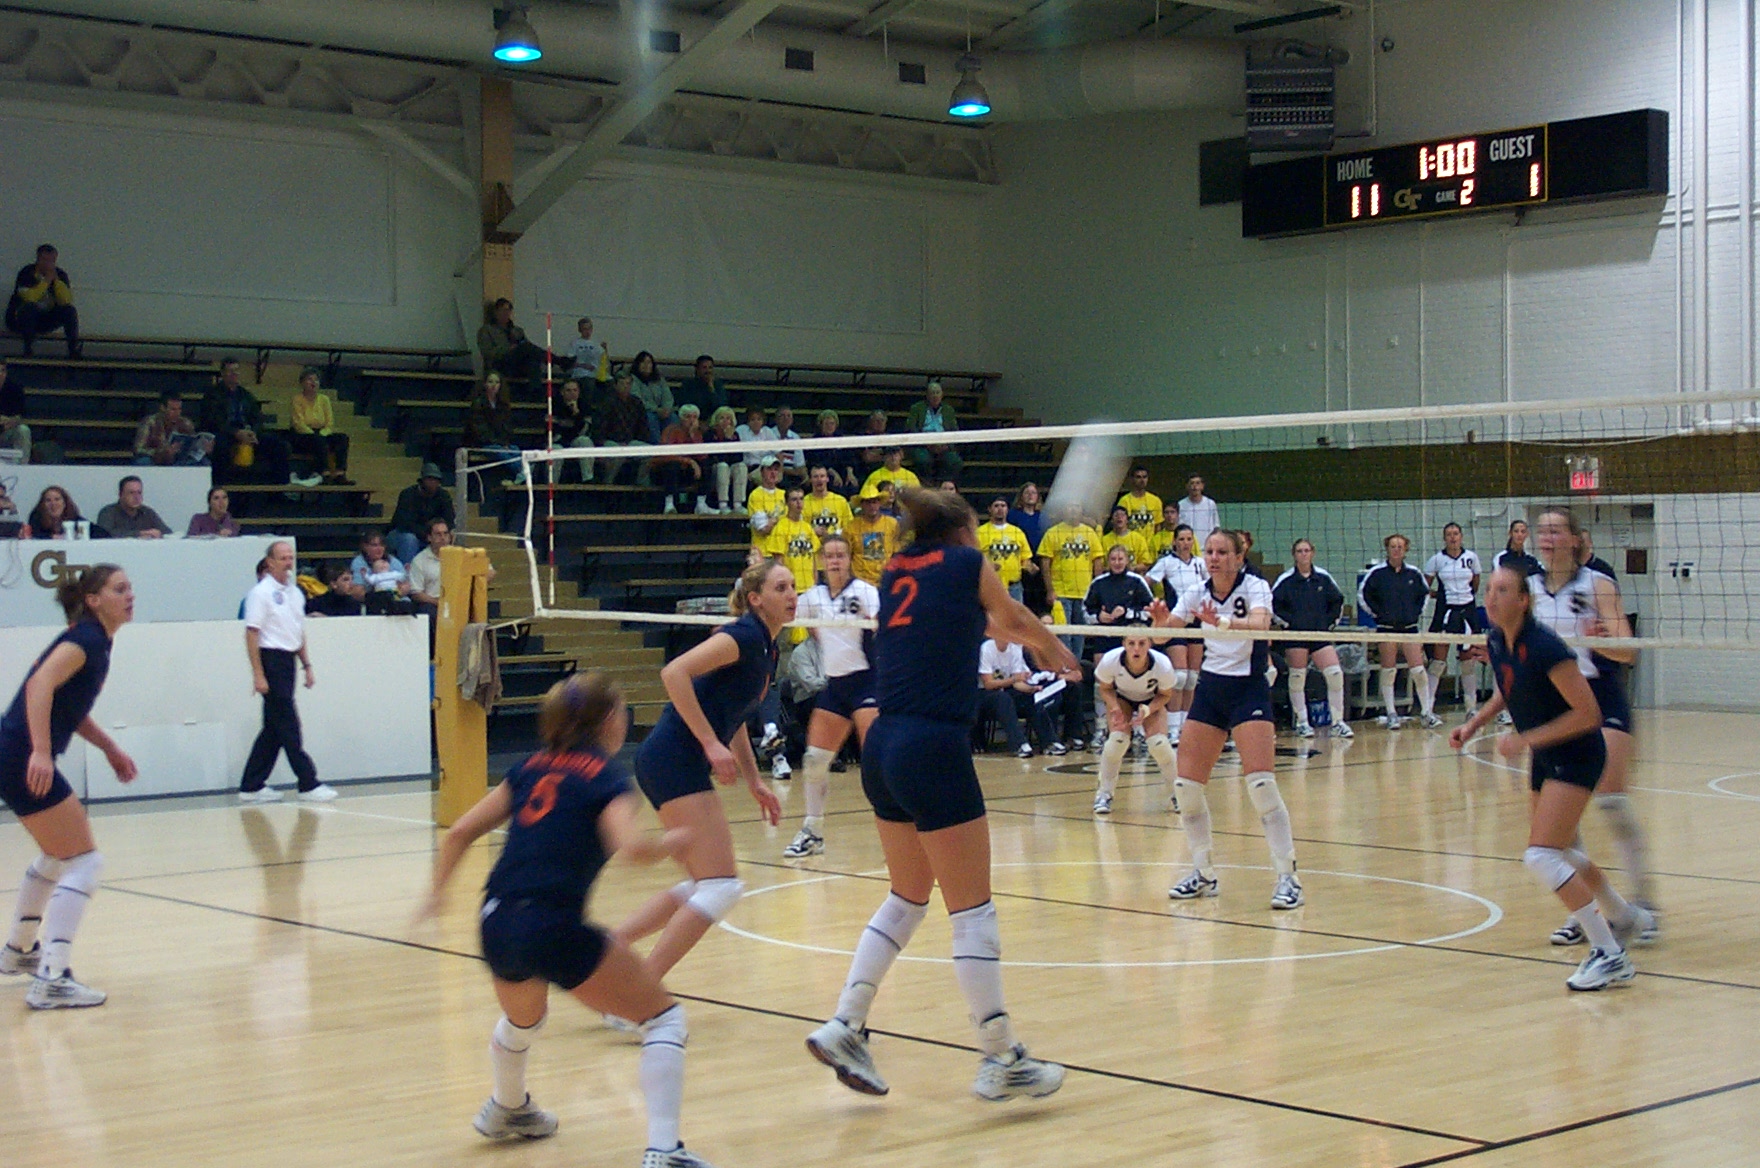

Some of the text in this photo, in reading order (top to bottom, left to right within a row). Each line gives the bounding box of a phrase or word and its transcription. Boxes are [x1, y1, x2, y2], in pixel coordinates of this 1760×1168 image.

[1419, 140, 1476, 180] 1:00
[1489, 135, 1535, 161] GUEST
[1337, 157, 1374, 182] HOME
[1529, 163, 1539, 197] 1
[1351, 183, 1379, 219] 11
[1435, 179, 1474, 206] GAME 2
[886, 575, 919, 628] 2
[1233, 596, 1247, 618] 9
